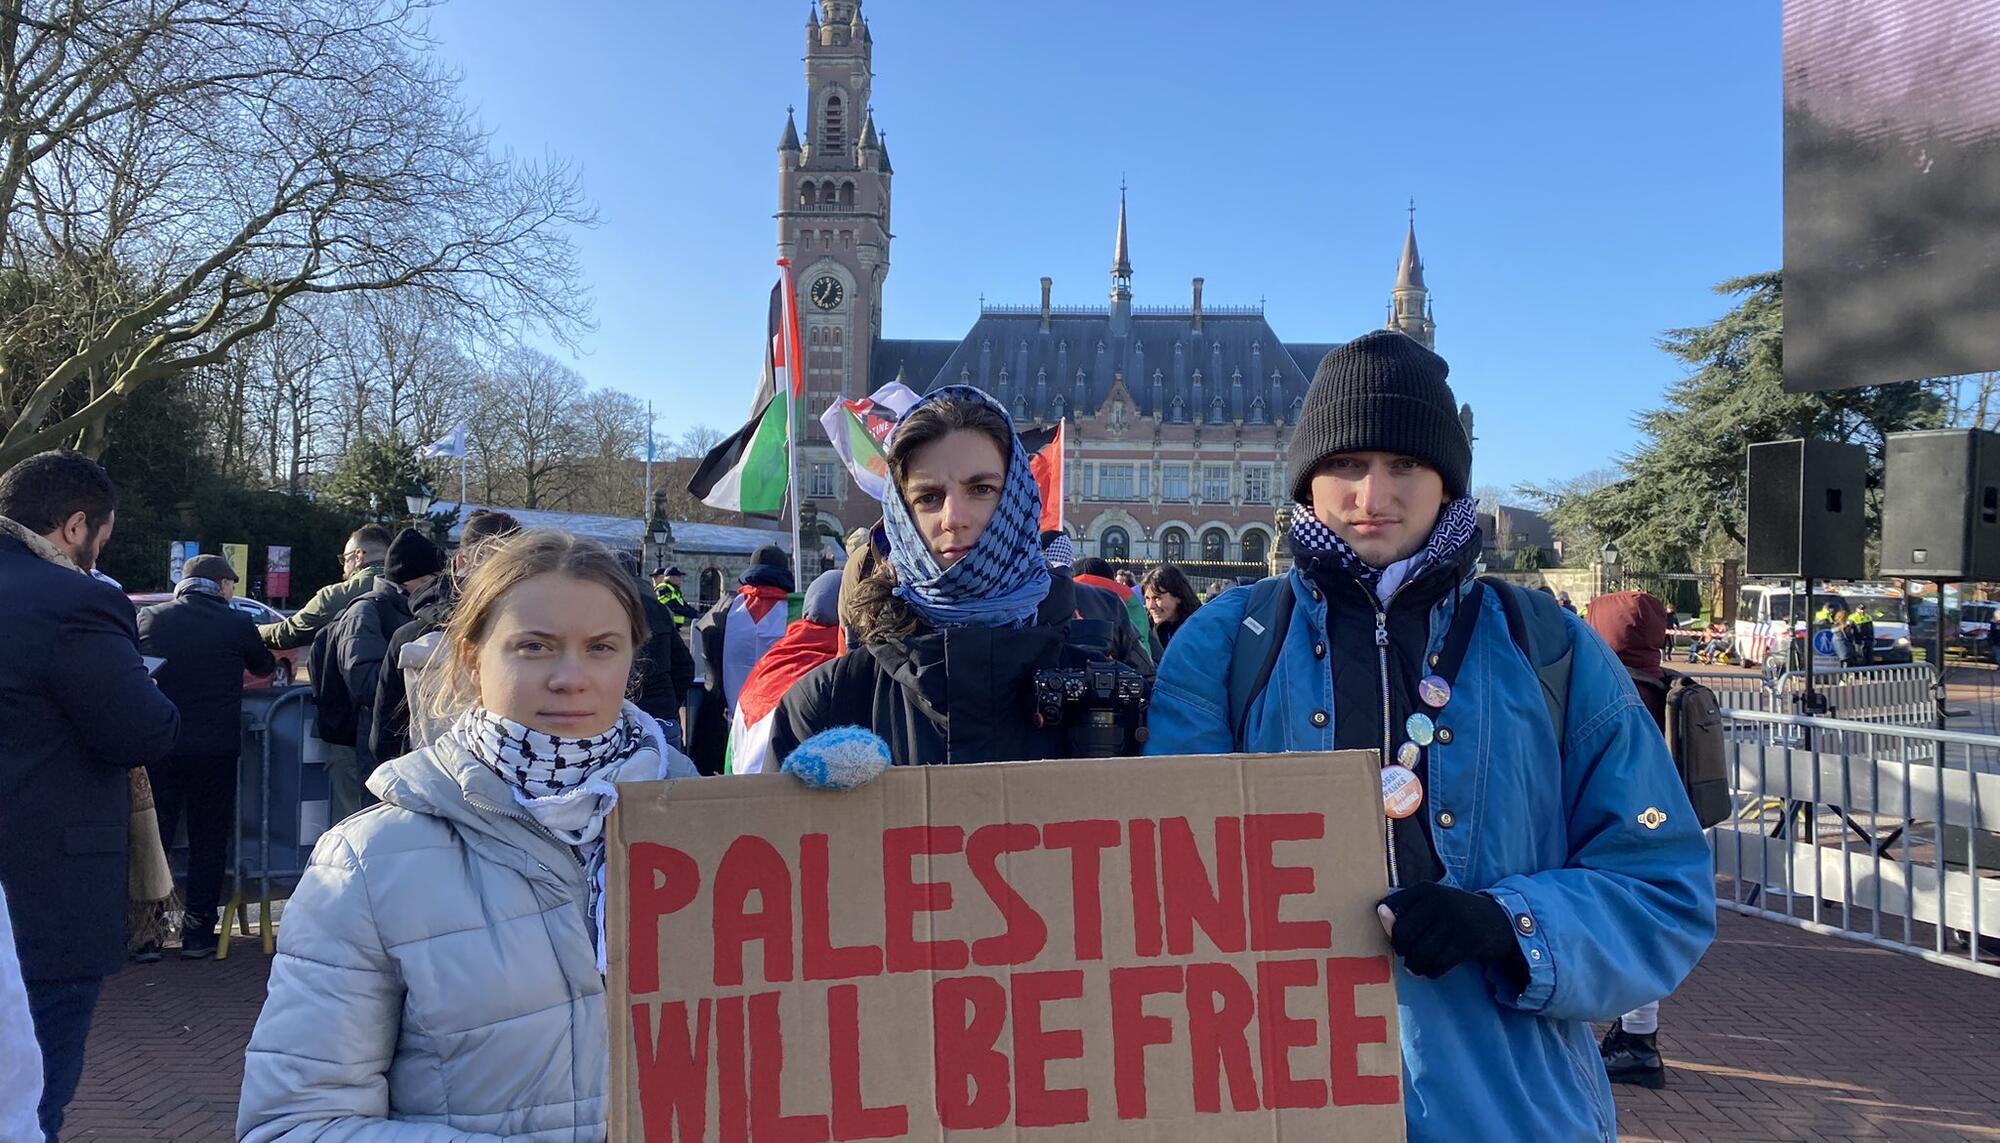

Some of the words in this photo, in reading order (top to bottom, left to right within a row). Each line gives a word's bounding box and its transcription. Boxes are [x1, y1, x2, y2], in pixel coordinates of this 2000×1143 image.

[1384, 776, 1408, 799] BANKS
[629, 812, 1332, 994] PALESTINE
[631, 984, 909, 1143] WILL
[933, 969, 1089, 1130] BE
[1110, 956, 1400, 1120] FREE
